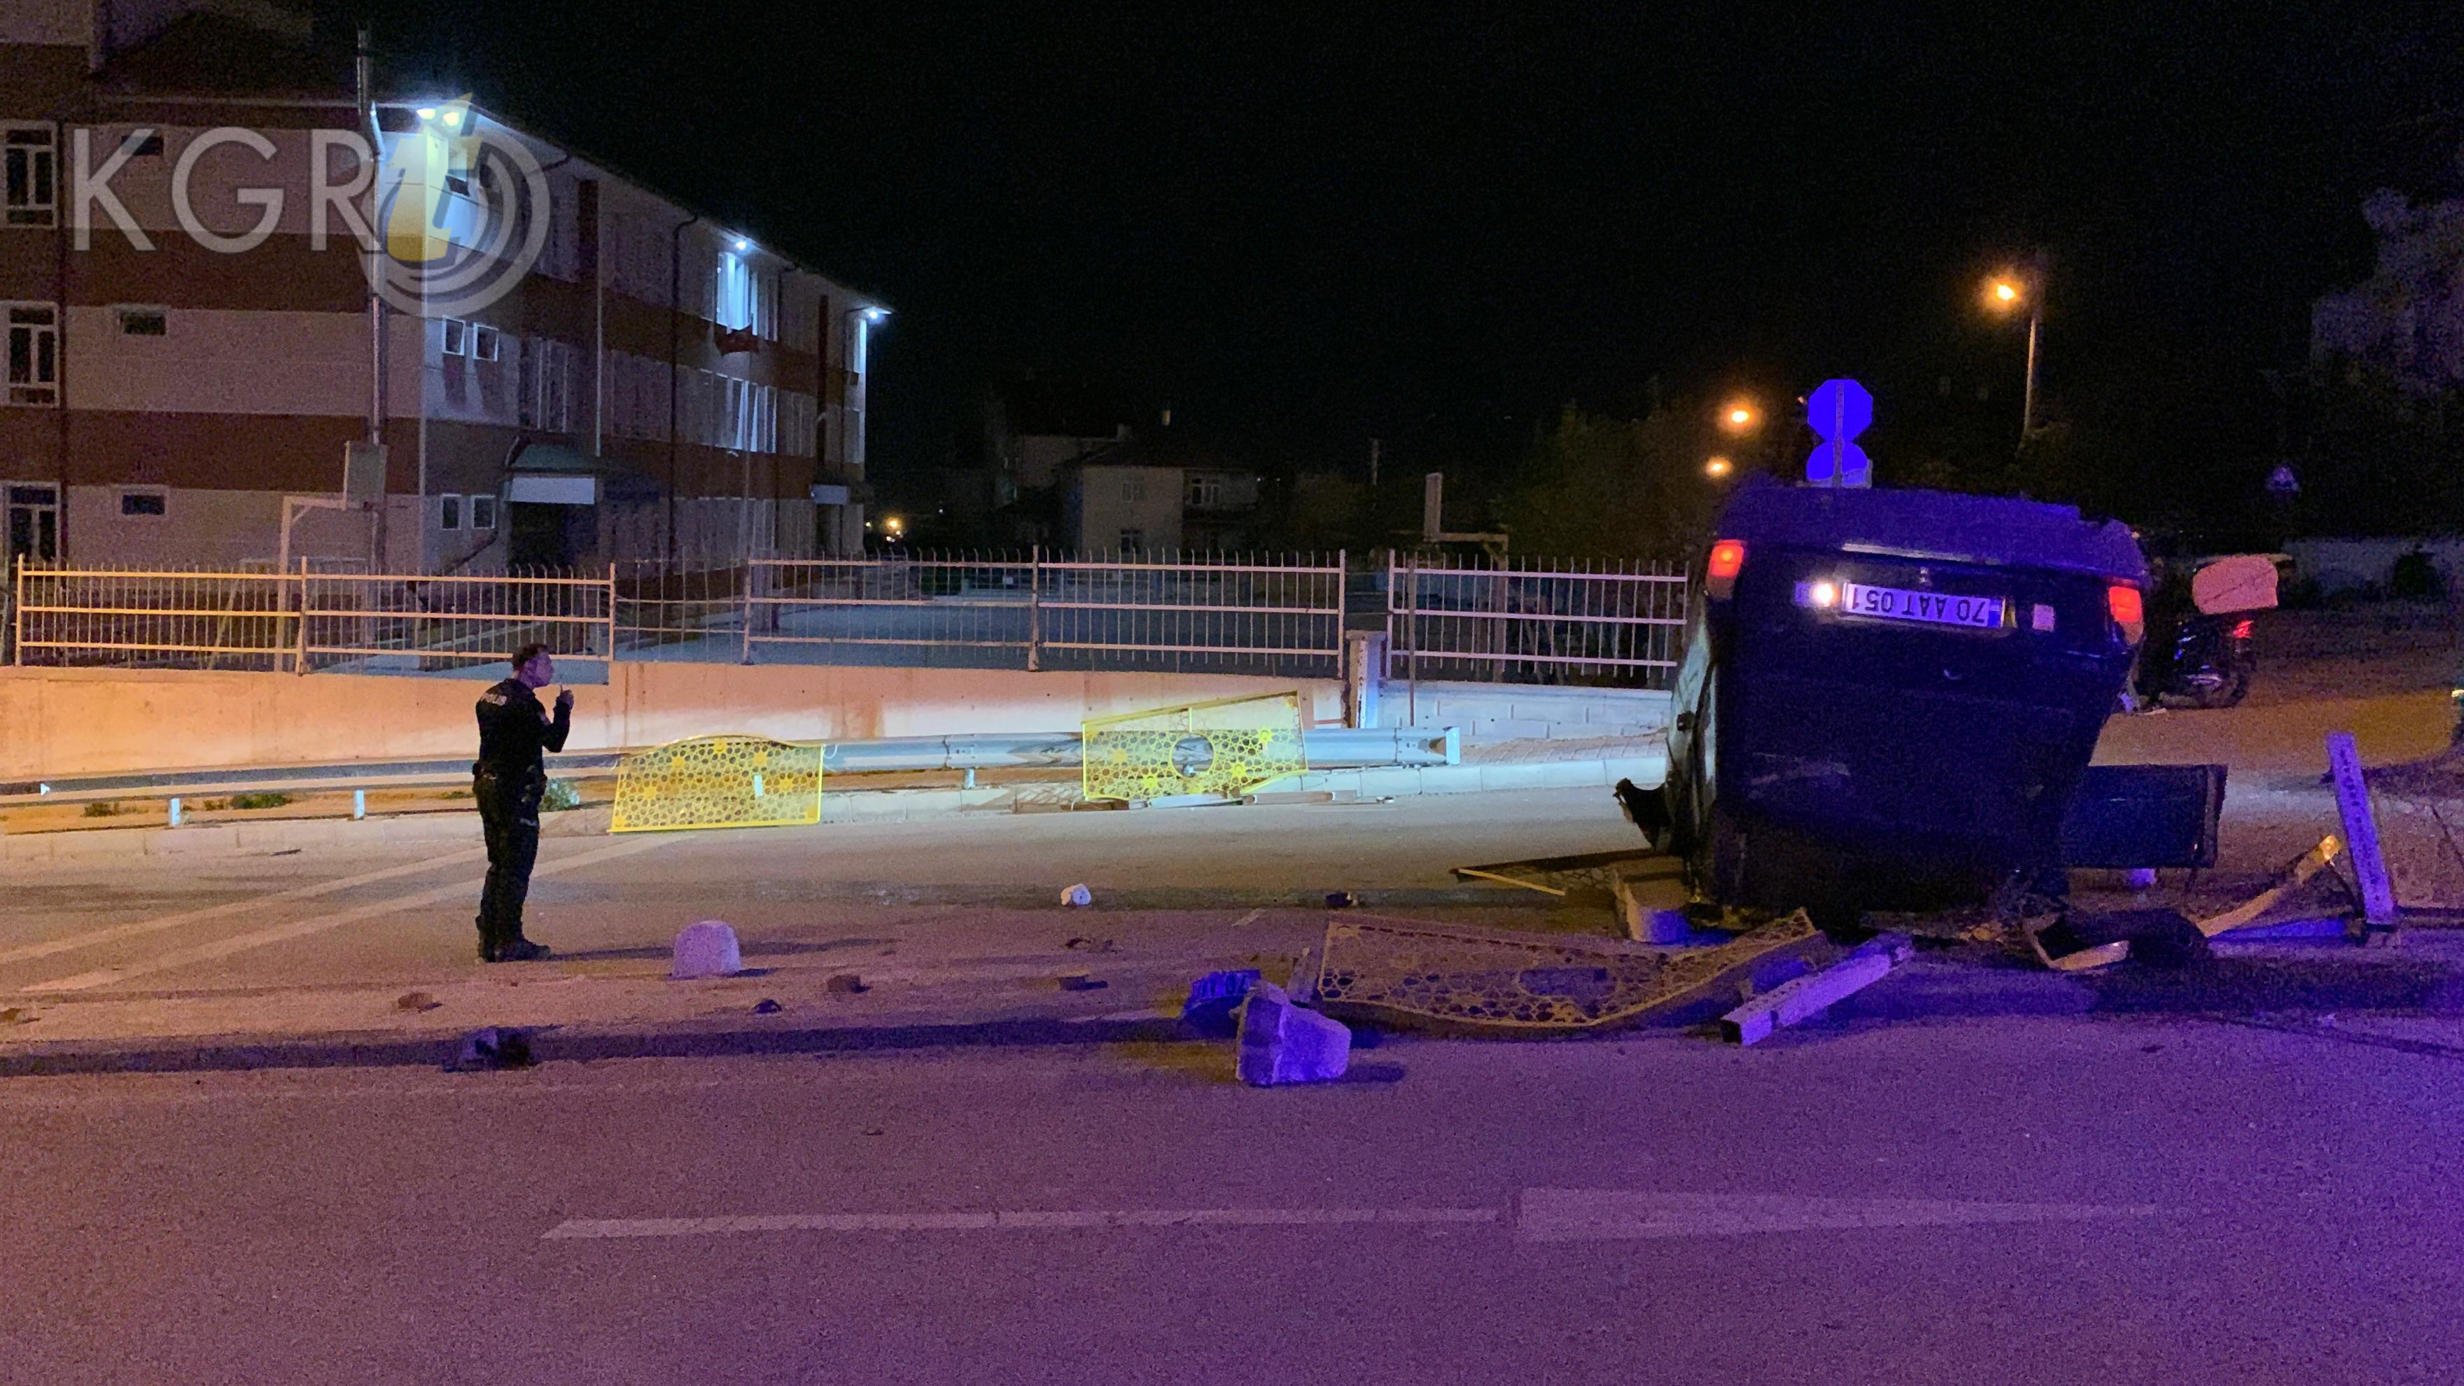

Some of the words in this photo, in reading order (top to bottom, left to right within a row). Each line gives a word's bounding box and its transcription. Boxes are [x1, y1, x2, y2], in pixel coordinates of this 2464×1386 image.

[1851, 588, 1895, 612] 051
[1902, 594, 1947, 619] AAT
[1956, 598, 1986, 624] 70
